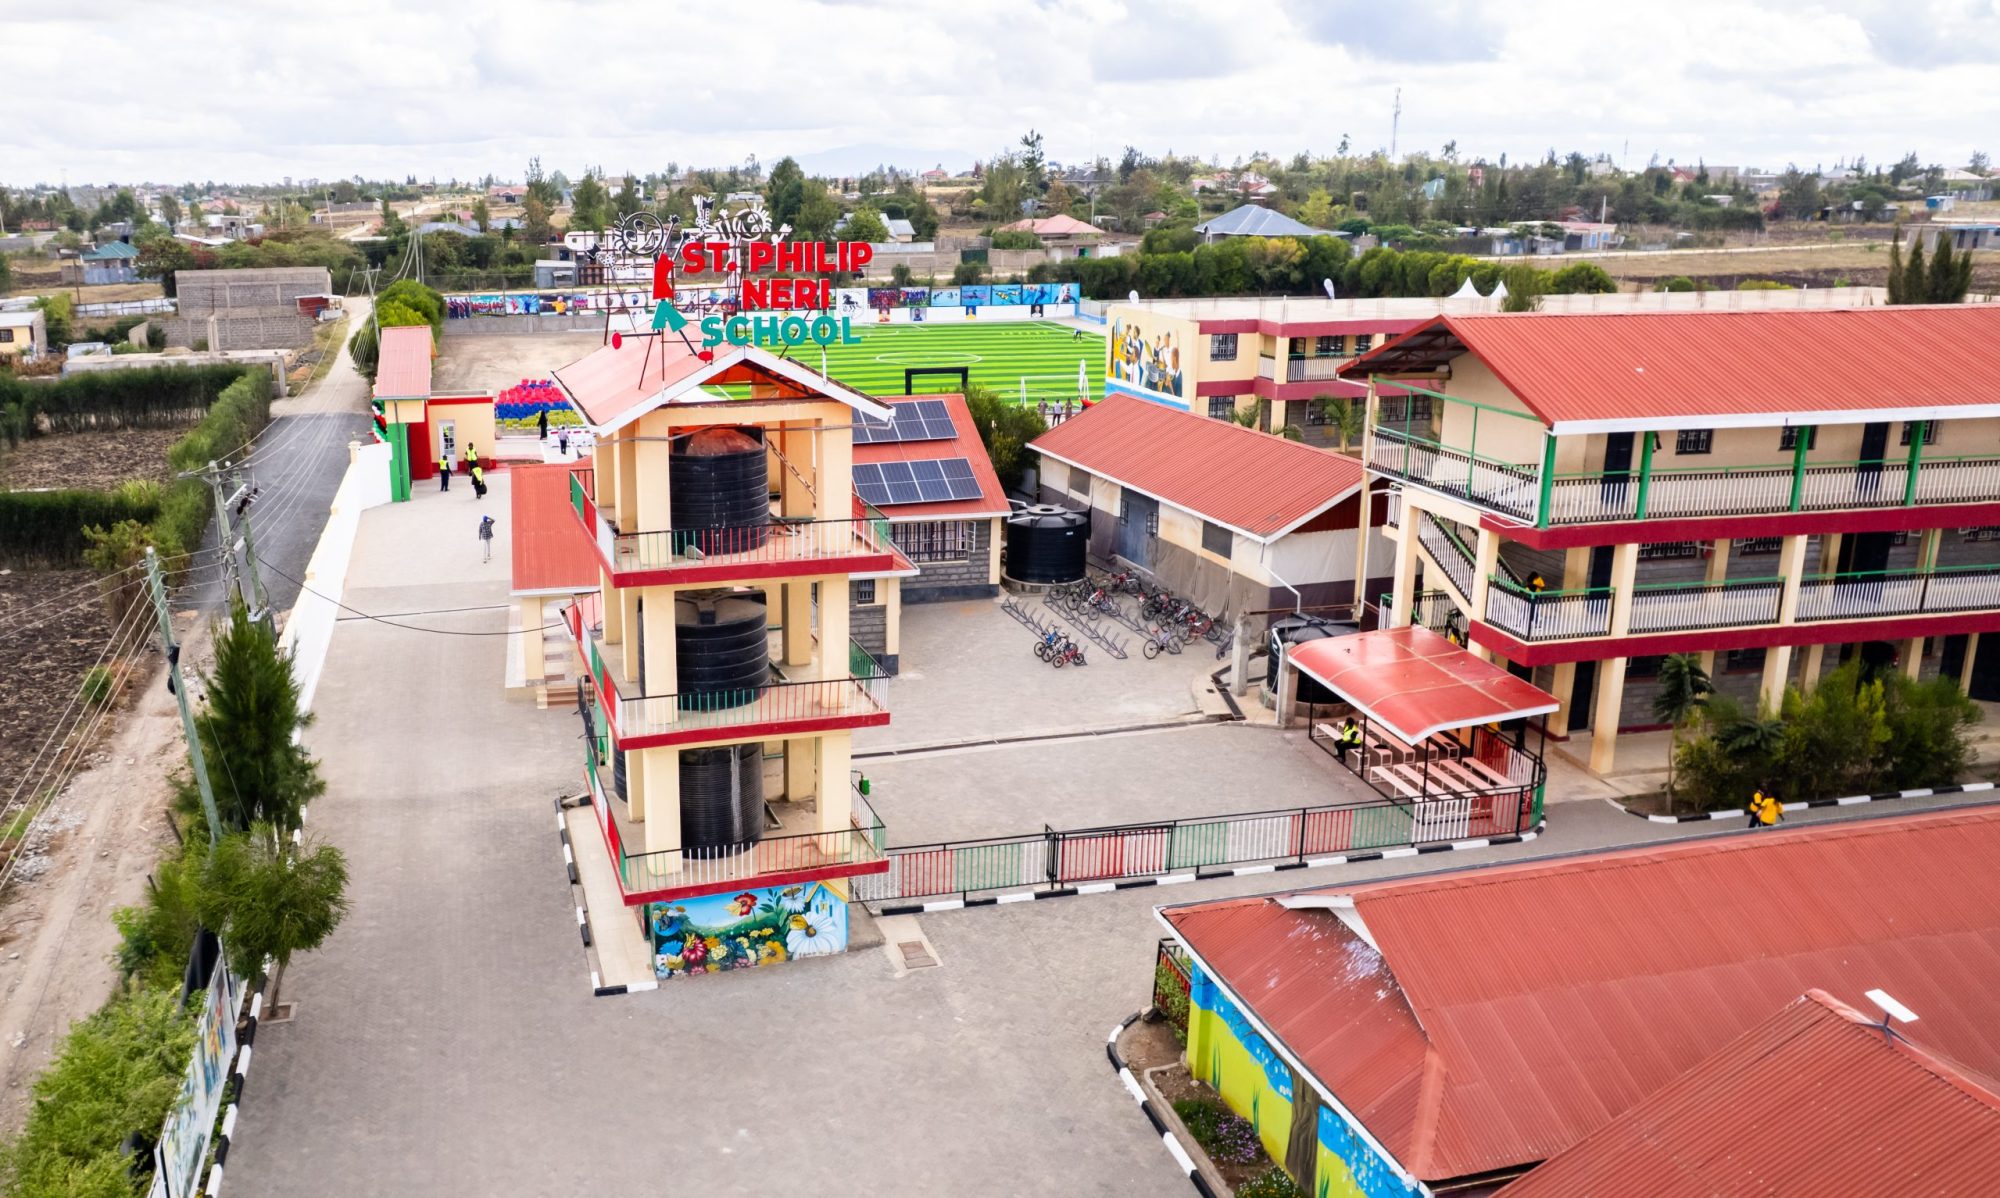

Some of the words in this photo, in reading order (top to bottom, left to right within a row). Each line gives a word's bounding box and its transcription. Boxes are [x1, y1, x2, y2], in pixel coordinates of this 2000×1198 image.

[681, 241, 737, 272] ST.
[749, 241, 873, 272] PHILIP
[741, 278, 830, 309] NERI
[700, 315, 861, 347] SCHOOL
